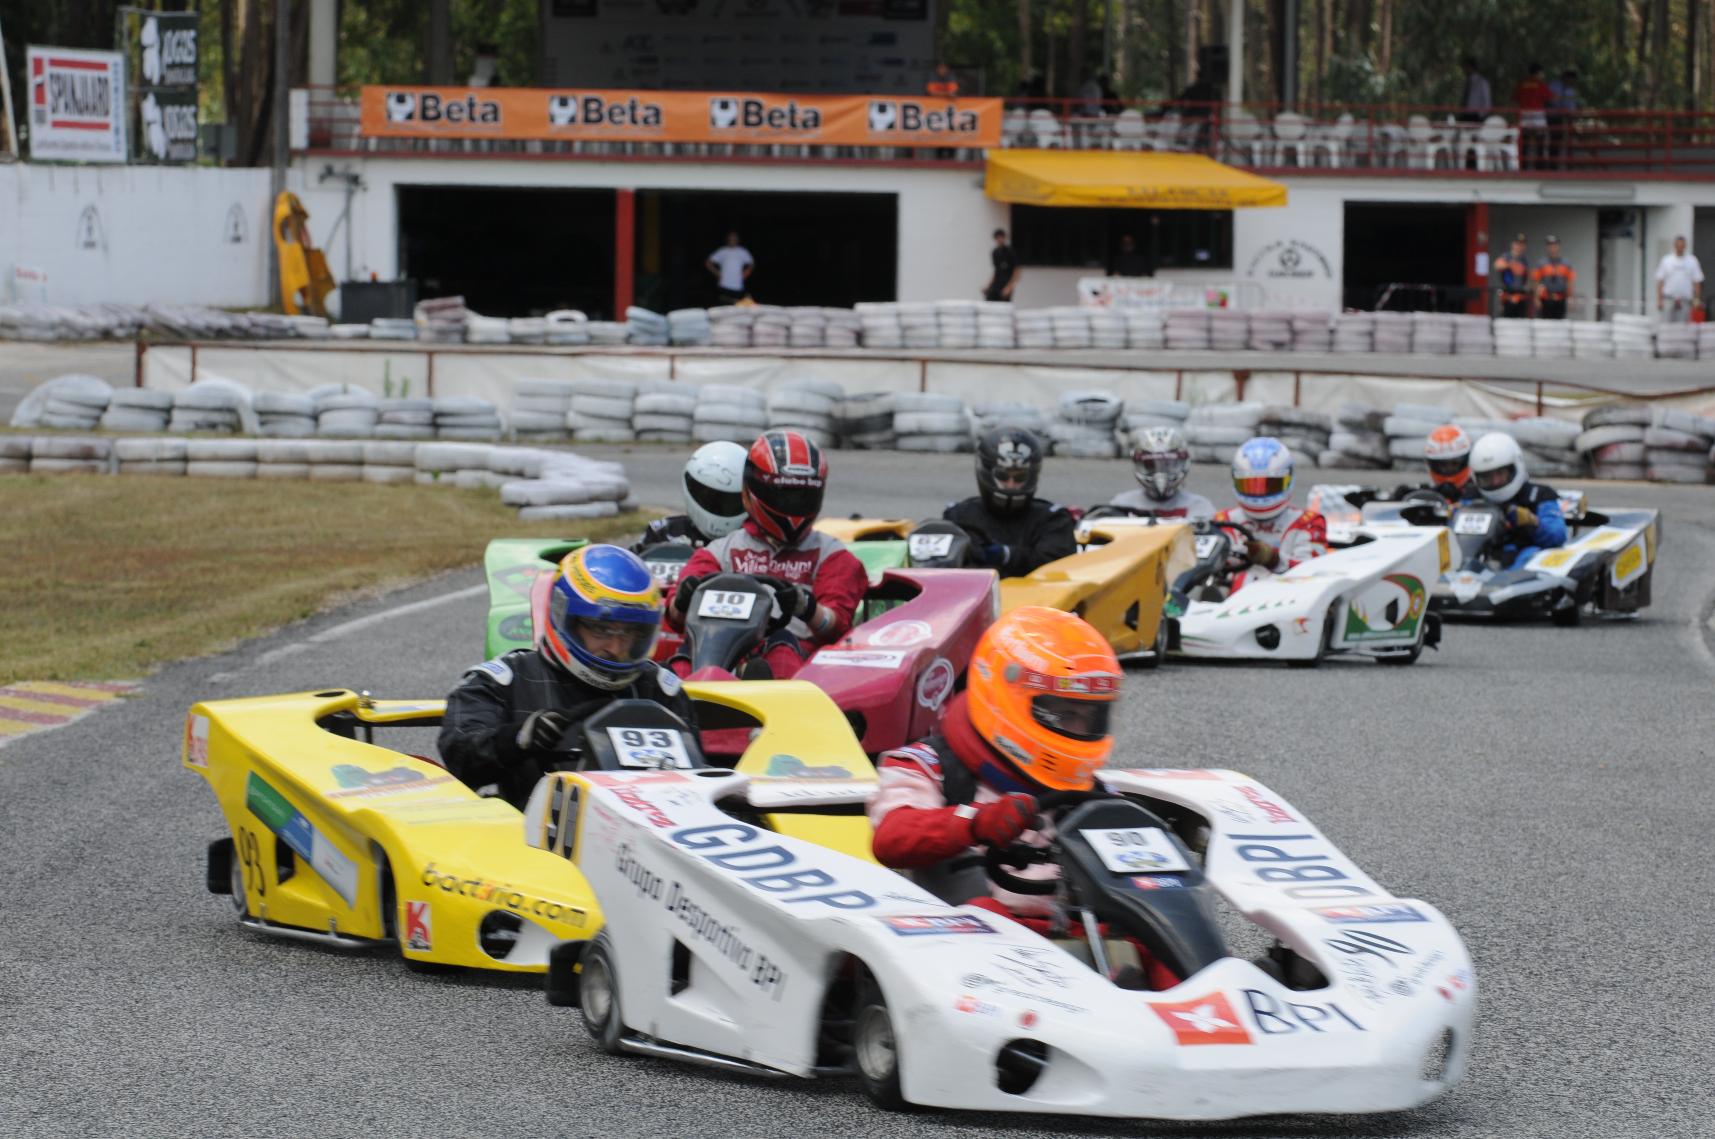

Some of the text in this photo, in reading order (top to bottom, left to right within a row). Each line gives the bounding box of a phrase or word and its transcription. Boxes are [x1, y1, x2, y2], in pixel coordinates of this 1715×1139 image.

[420, 94, 978, 132] Beta Beta Beta Beta
[713, 592, 745, 605] 10
[621, 730, 672, 748] 93
[239, 825, 266, 898] 93
[671, 823, 878, 910] GDBP
[1241, 988, 1370, 1035] BPI
